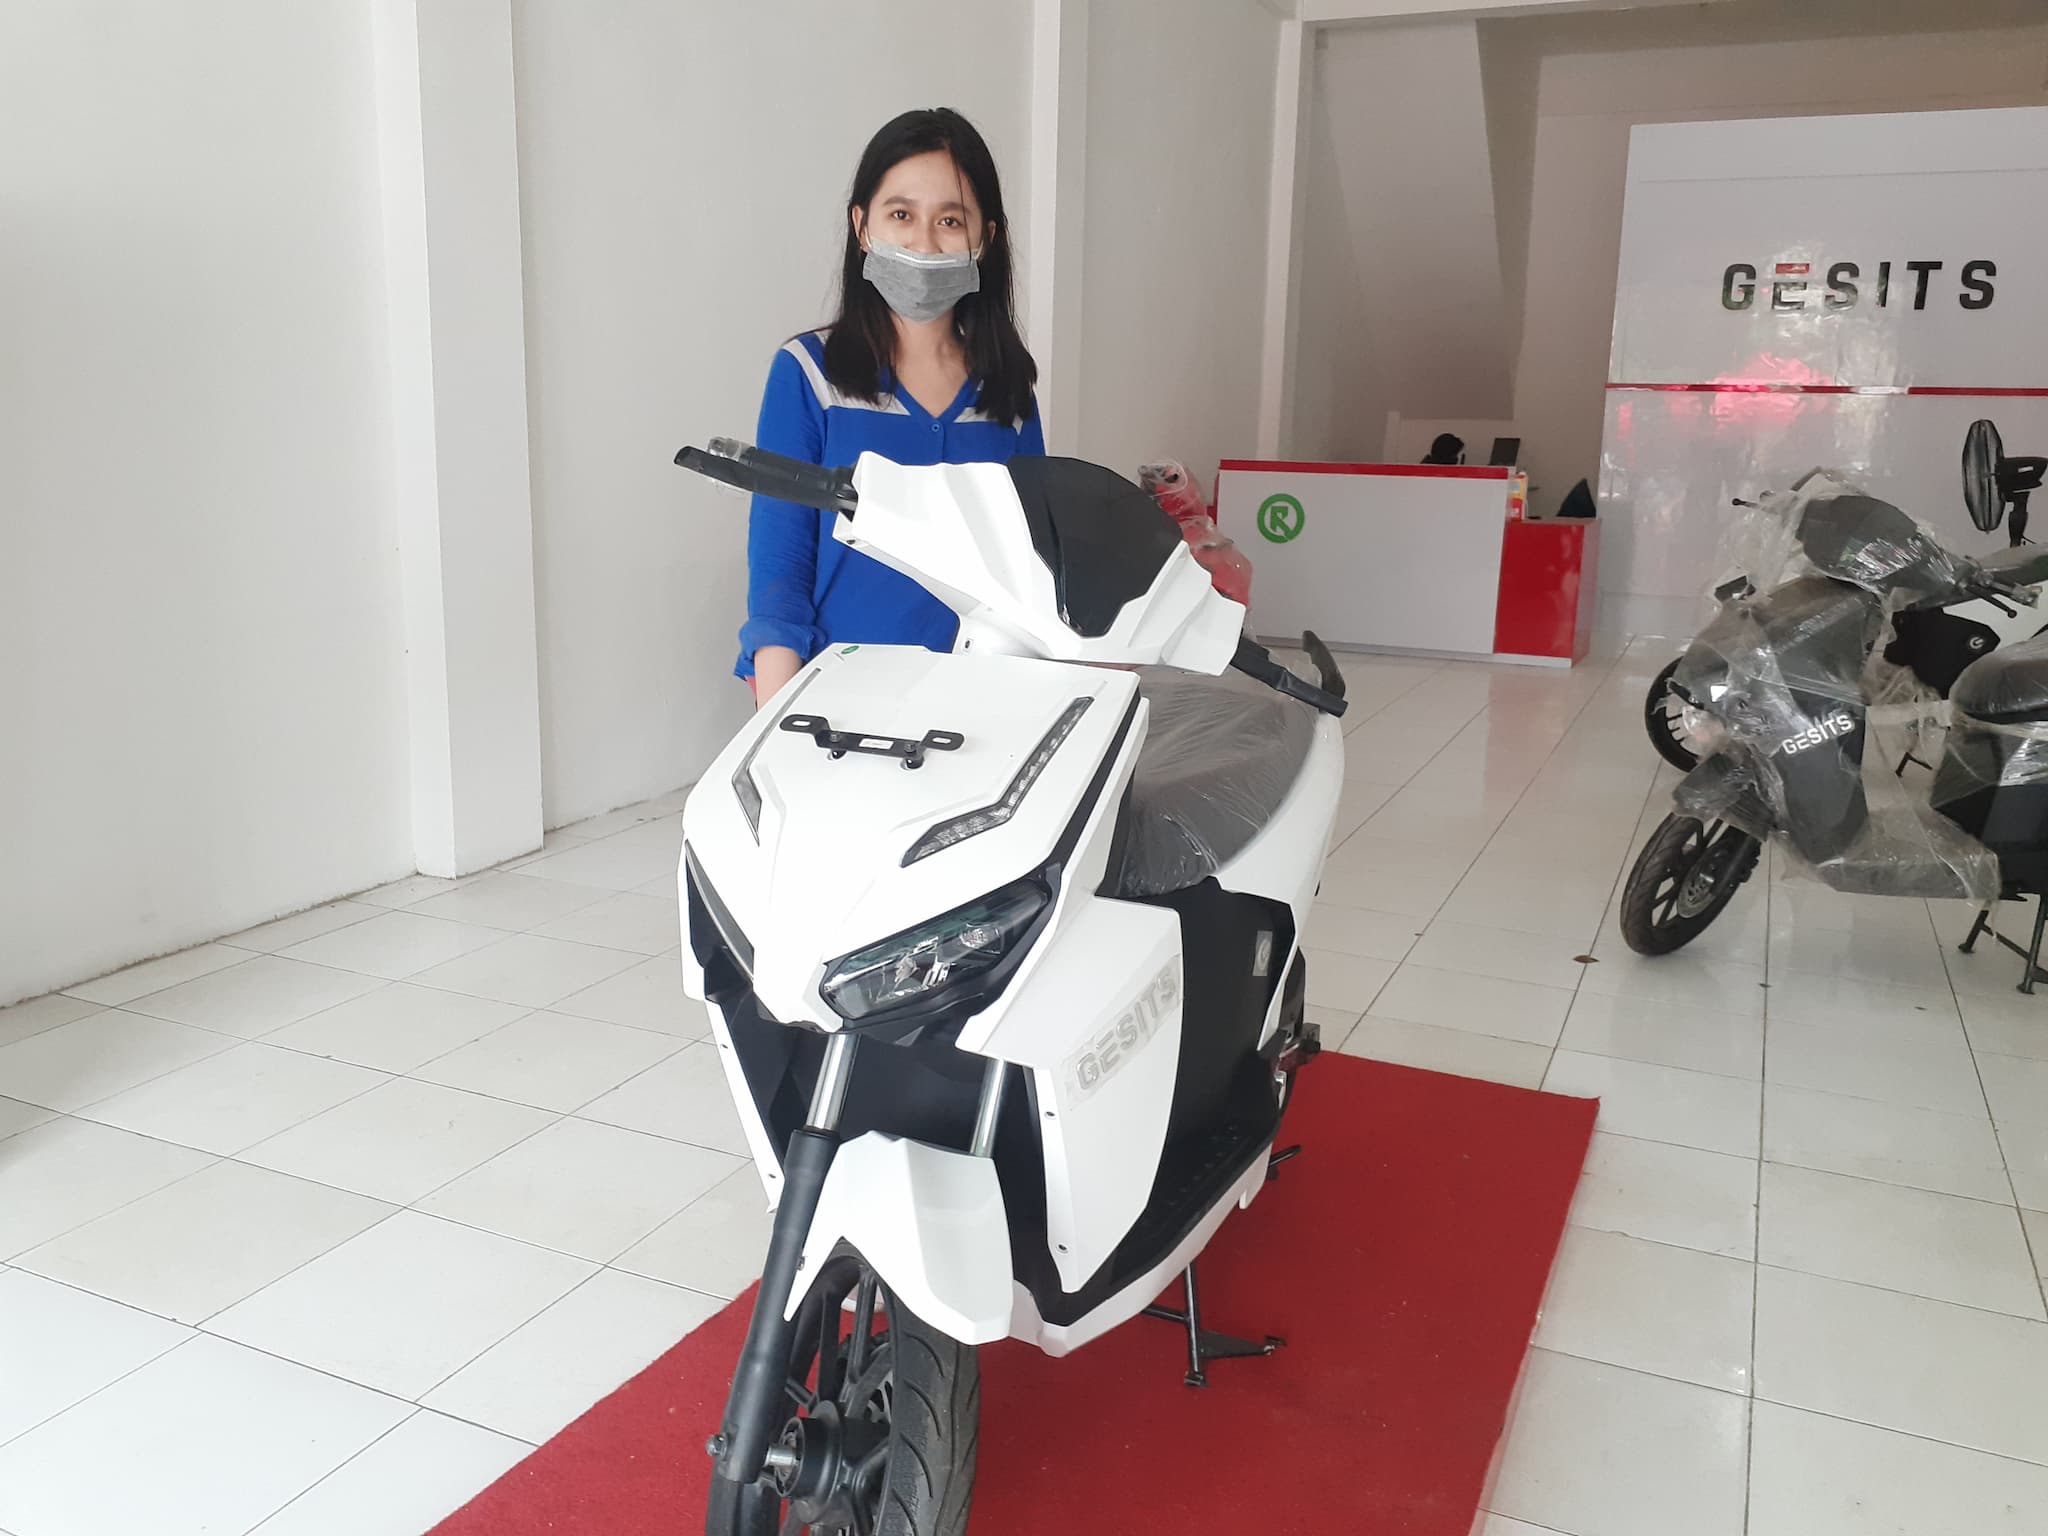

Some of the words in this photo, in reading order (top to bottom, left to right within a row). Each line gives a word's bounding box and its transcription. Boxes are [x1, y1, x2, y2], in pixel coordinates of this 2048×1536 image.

[1721, 260, 1997, 311] GESITS
[1782, 714, 1853, 754] GESITS
[1076, 966, 1176, 1090] GESITS
